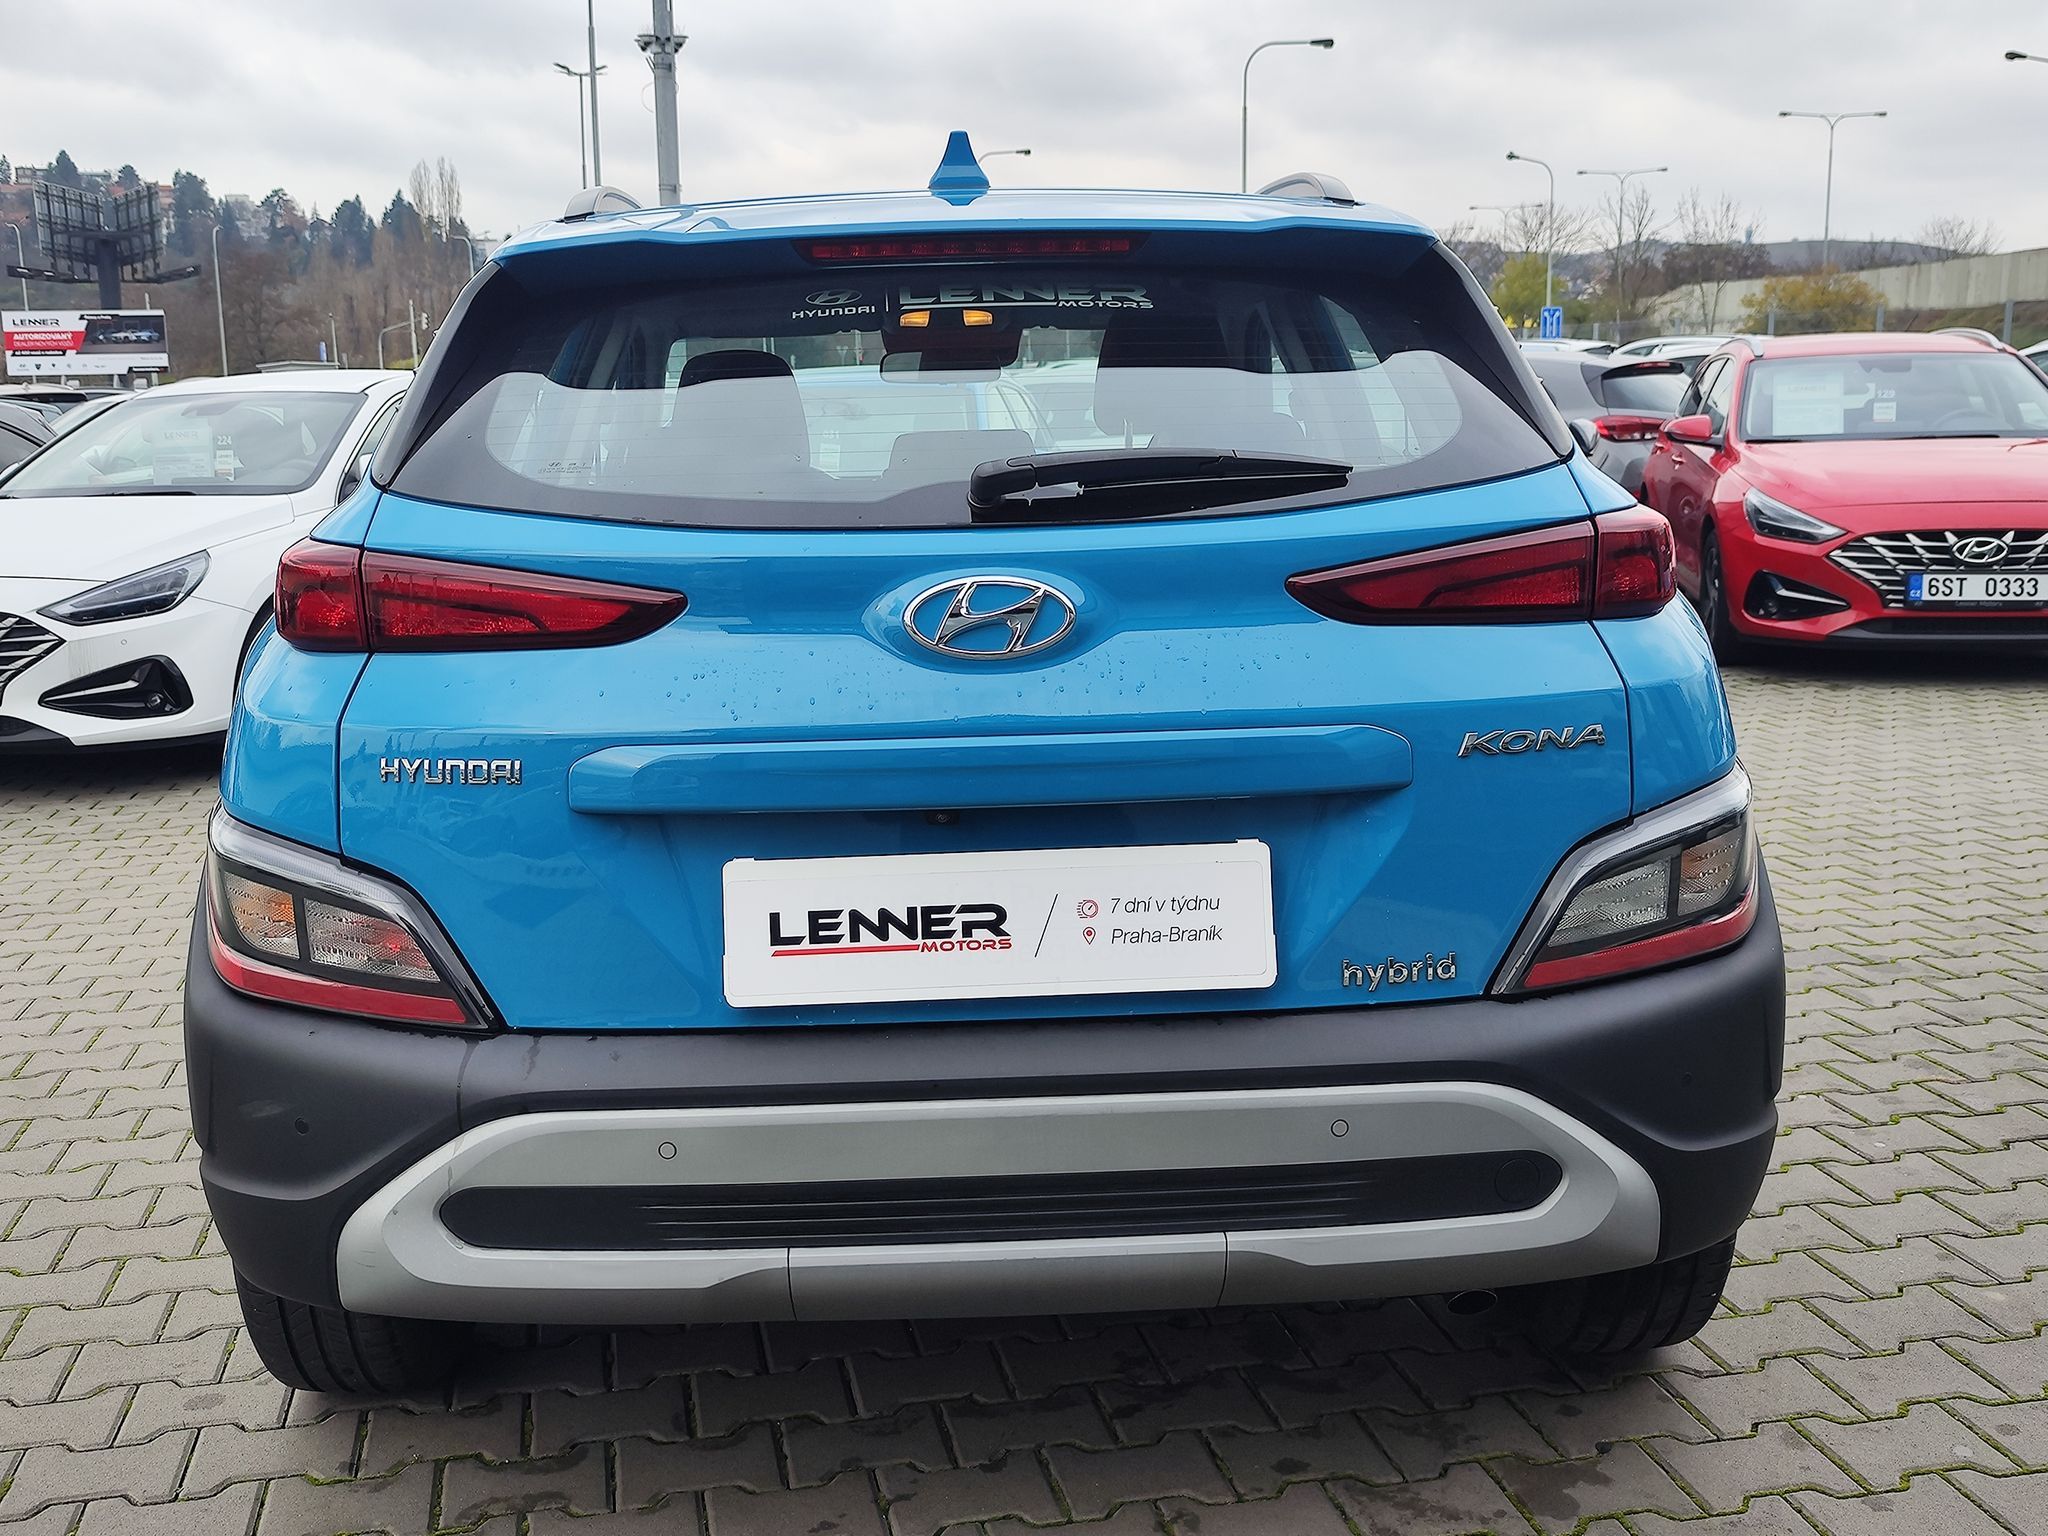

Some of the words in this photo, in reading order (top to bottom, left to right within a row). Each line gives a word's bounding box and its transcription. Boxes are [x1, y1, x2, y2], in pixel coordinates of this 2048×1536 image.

[899, 283, 1151, 303] LENNER
[792, 304, 876, 319] HYUNDAI
[1058, 300, 1154, 309] MOTORS
[217, 436, 232, 445] 224
[1928, 577, 1967, 597] 6ST
[1985, 577, 2039, 597] 0333
[1457, 724, 1606, 757] KONA
[380, 757, 522, 784] HYUNDAI
[1111, 898, 1121, 914] 7
[1124, 896, 1152, 913] dní
[1155, 900, 1166, 912] v
[1170, 895, 1220, 915] týdnu
[769, 903, 1011, 946] LENNER
[1111, 925, 1223, 944] Praha-Braník
[920, 939, 1012, 953] MOTORS
[1342, 952, 1456, 991] hybrid
